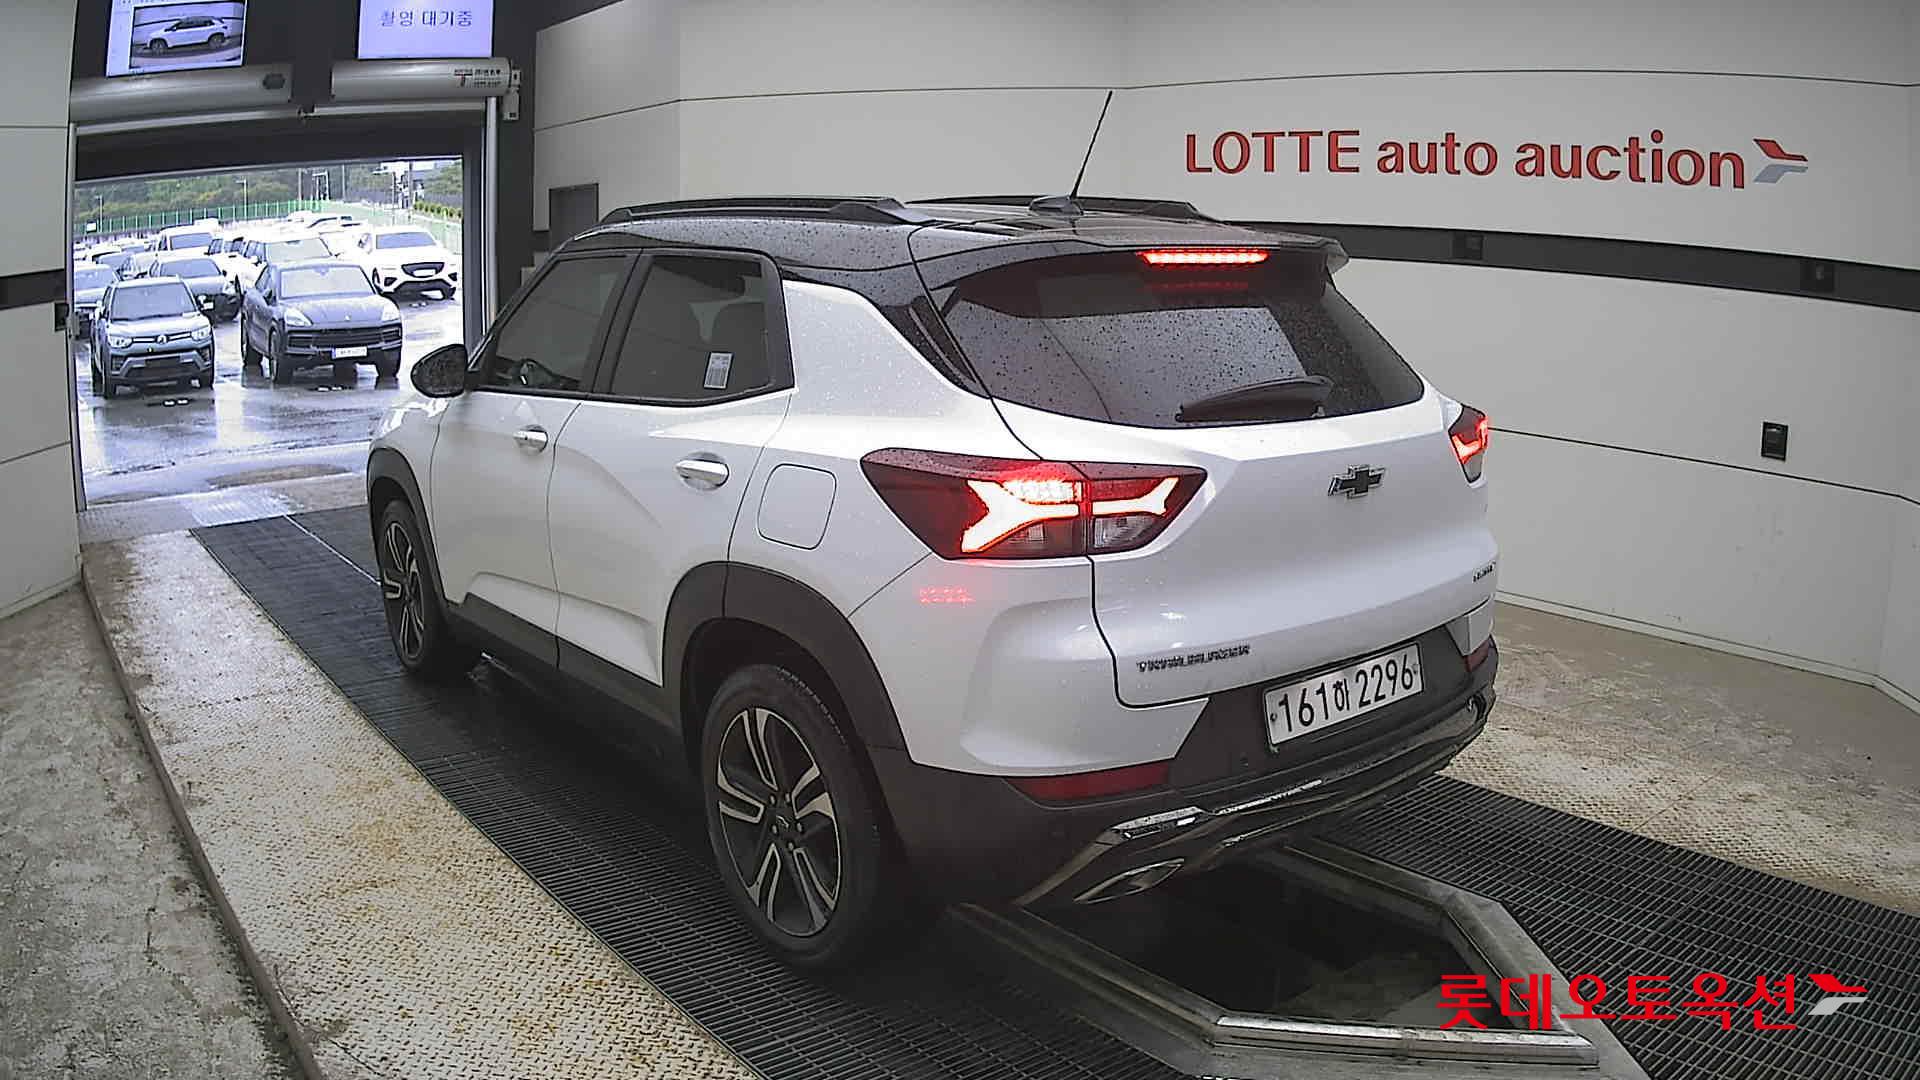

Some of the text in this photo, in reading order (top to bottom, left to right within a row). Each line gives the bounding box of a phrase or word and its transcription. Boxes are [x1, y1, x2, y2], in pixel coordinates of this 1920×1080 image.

[422, 10, 473, 28] 대기중
[1185, 128, 1745, 190] LOTTE auto auction
[1354, 653, 1414, 709] 2296
